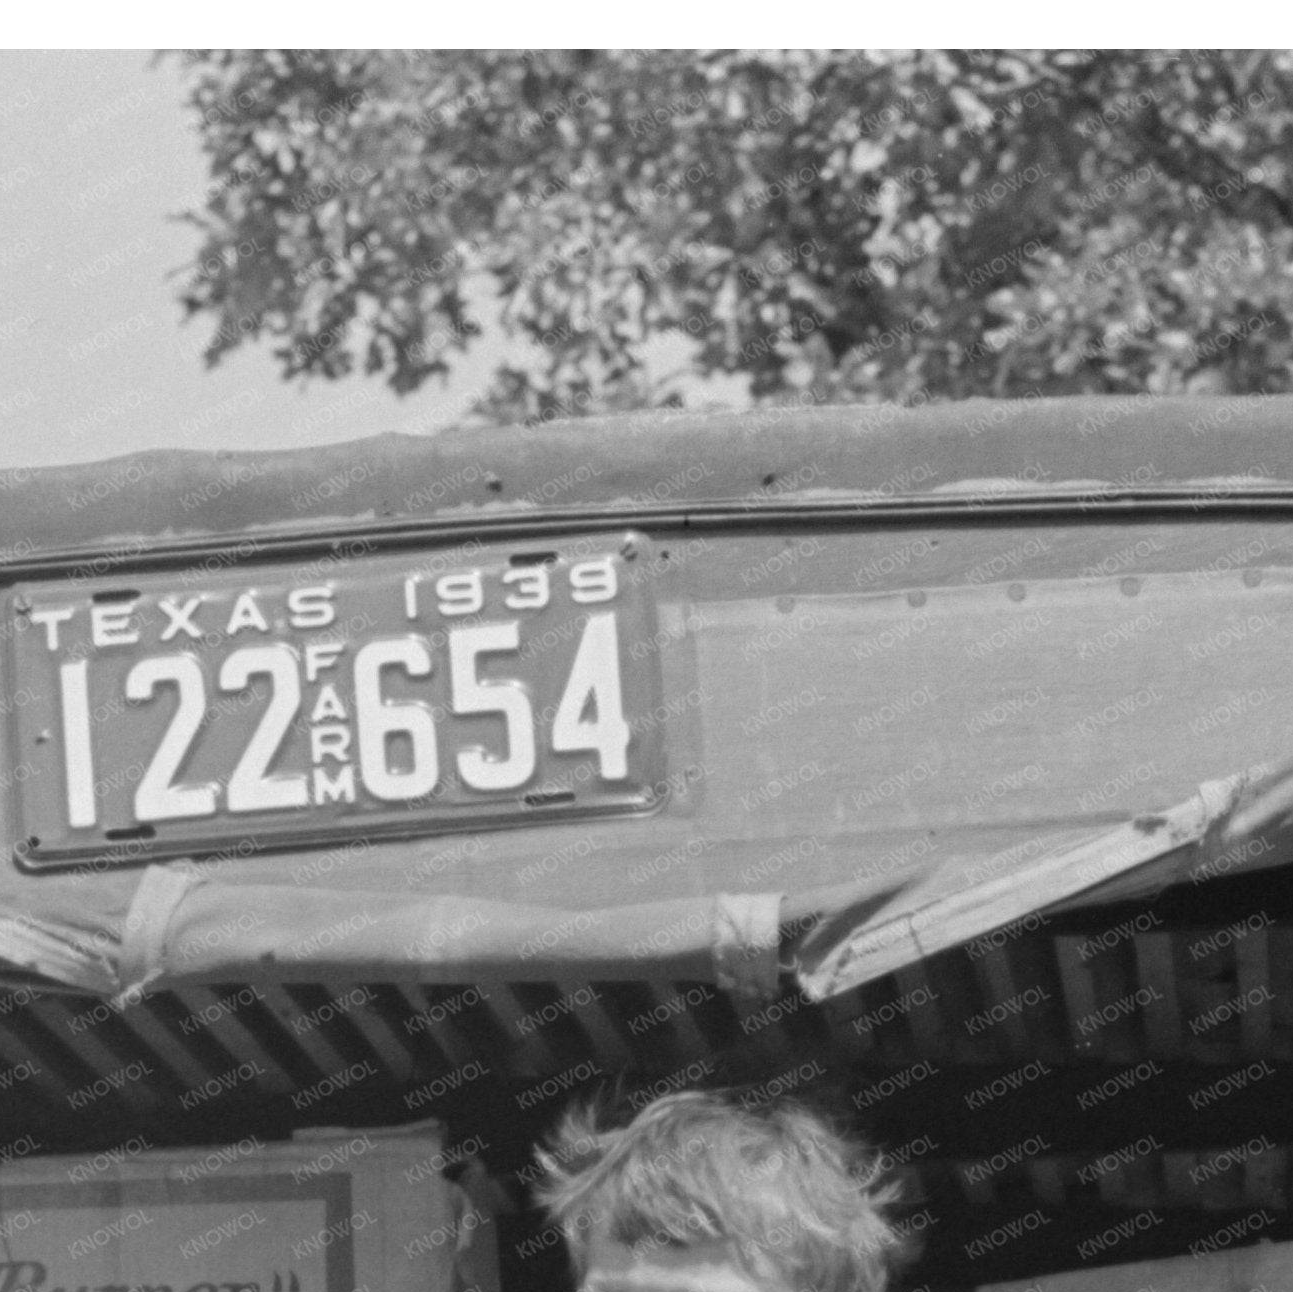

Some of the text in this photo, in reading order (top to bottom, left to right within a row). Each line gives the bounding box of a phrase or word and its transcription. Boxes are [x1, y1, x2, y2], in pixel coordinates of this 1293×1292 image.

[31, 559, 618, 651] TEXAS 1939
[305, 642, 355, 805] FARM
